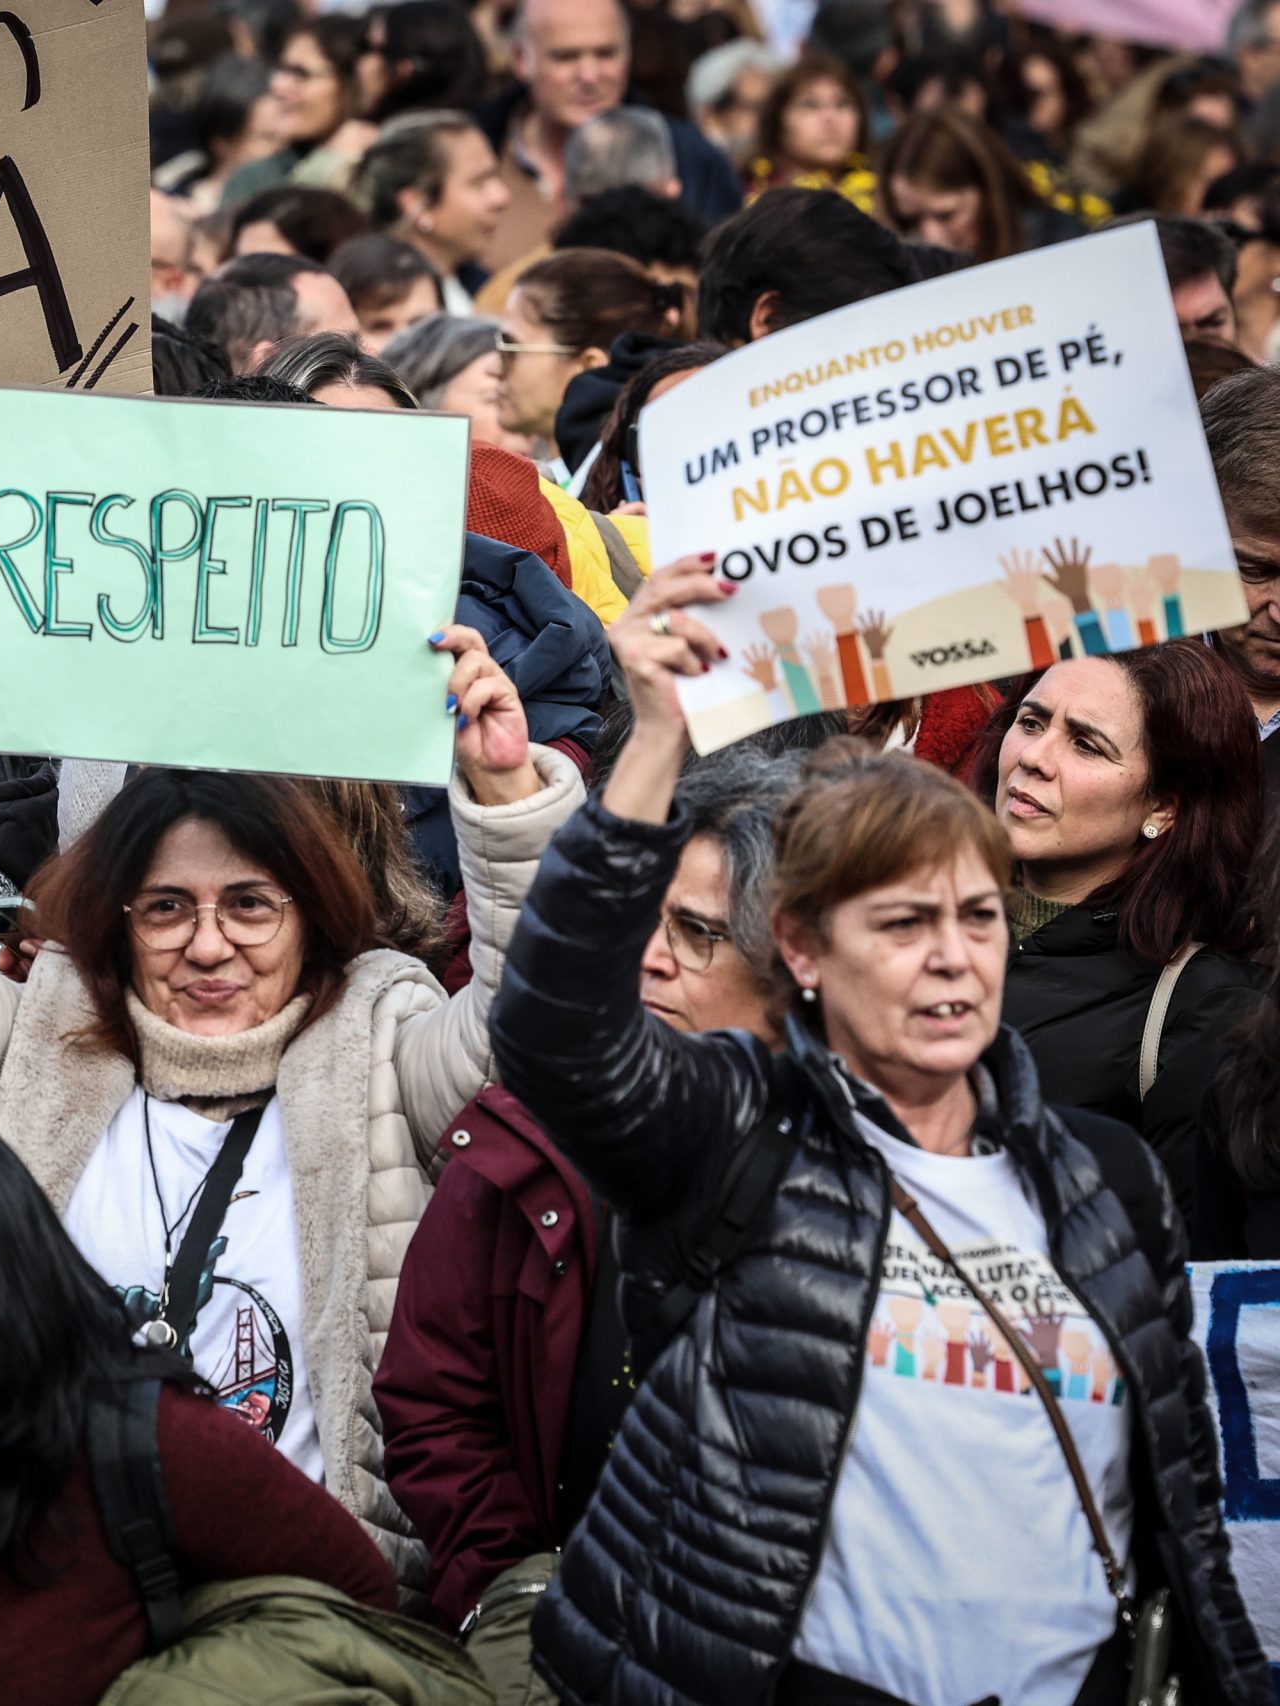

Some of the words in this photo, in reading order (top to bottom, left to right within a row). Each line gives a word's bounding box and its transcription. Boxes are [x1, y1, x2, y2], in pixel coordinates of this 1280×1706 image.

[684, 440, 740, 486] UM
[751, 366, 980, 457] PROFESSOR
[995, 349, 1049, 388] DE
[1062, 323, 1122, 377] PÉ,
[749, 341, 906, 408] ENQUANTO
[912, 305, 1036, 356] HOUVER
[716, 524, 847, 582] OVOS
[860, 507, 919, 549] DE
[934, 450, 1151, 532] JOELHOS!
[730, 457, 850, 521] NÃO
[865, 387, 1096, 485] HAVERÁ
[910, 639, 997, 668] VOSSA
